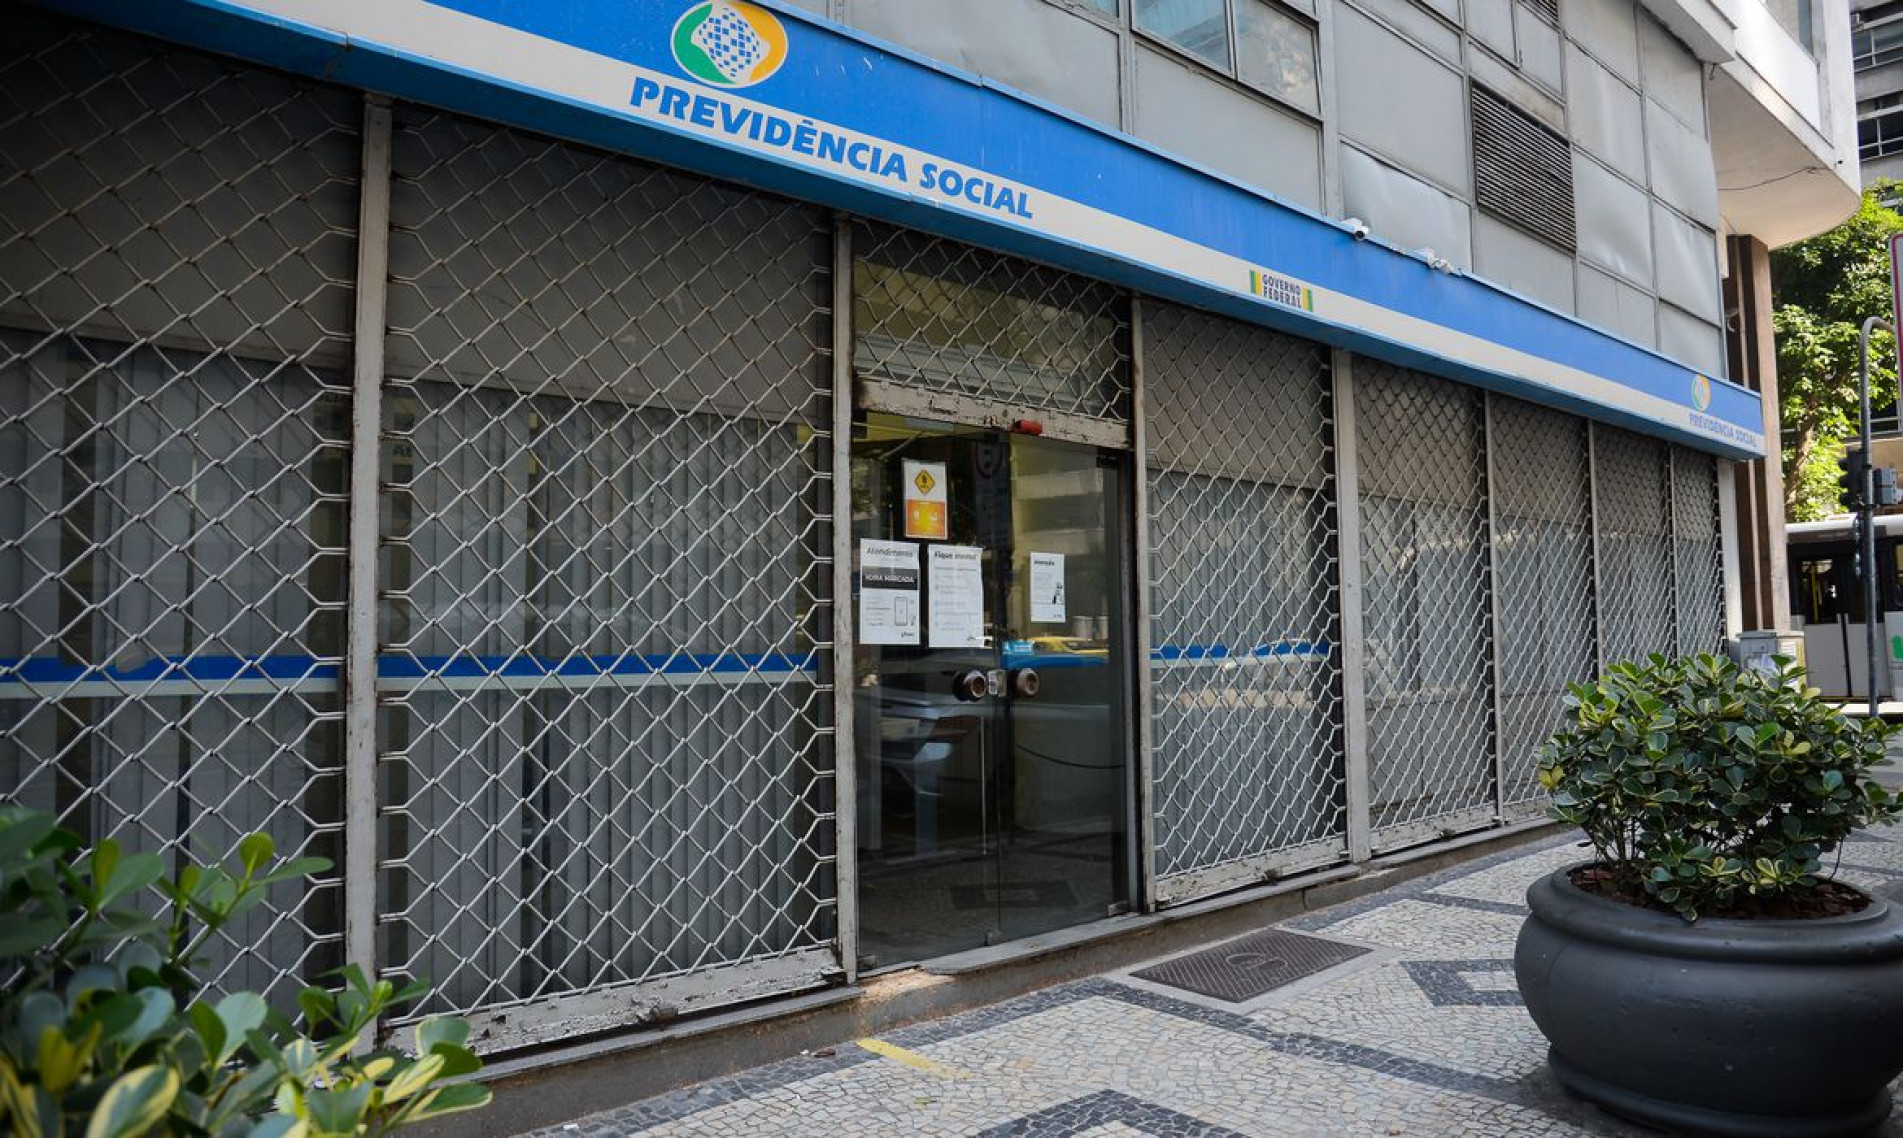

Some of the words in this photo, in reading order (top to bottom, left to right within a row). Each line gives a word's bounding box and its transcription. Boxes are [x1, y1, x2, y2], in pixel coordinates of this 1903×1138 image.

[630, 76, 907, 183] PREVIDÊNCIA
[920, 163, 1034, 219] SOCIAL
[1262, 274, 1301, 295] GOVERNO
[1263, 286, 1302, 309] FEDERAL
